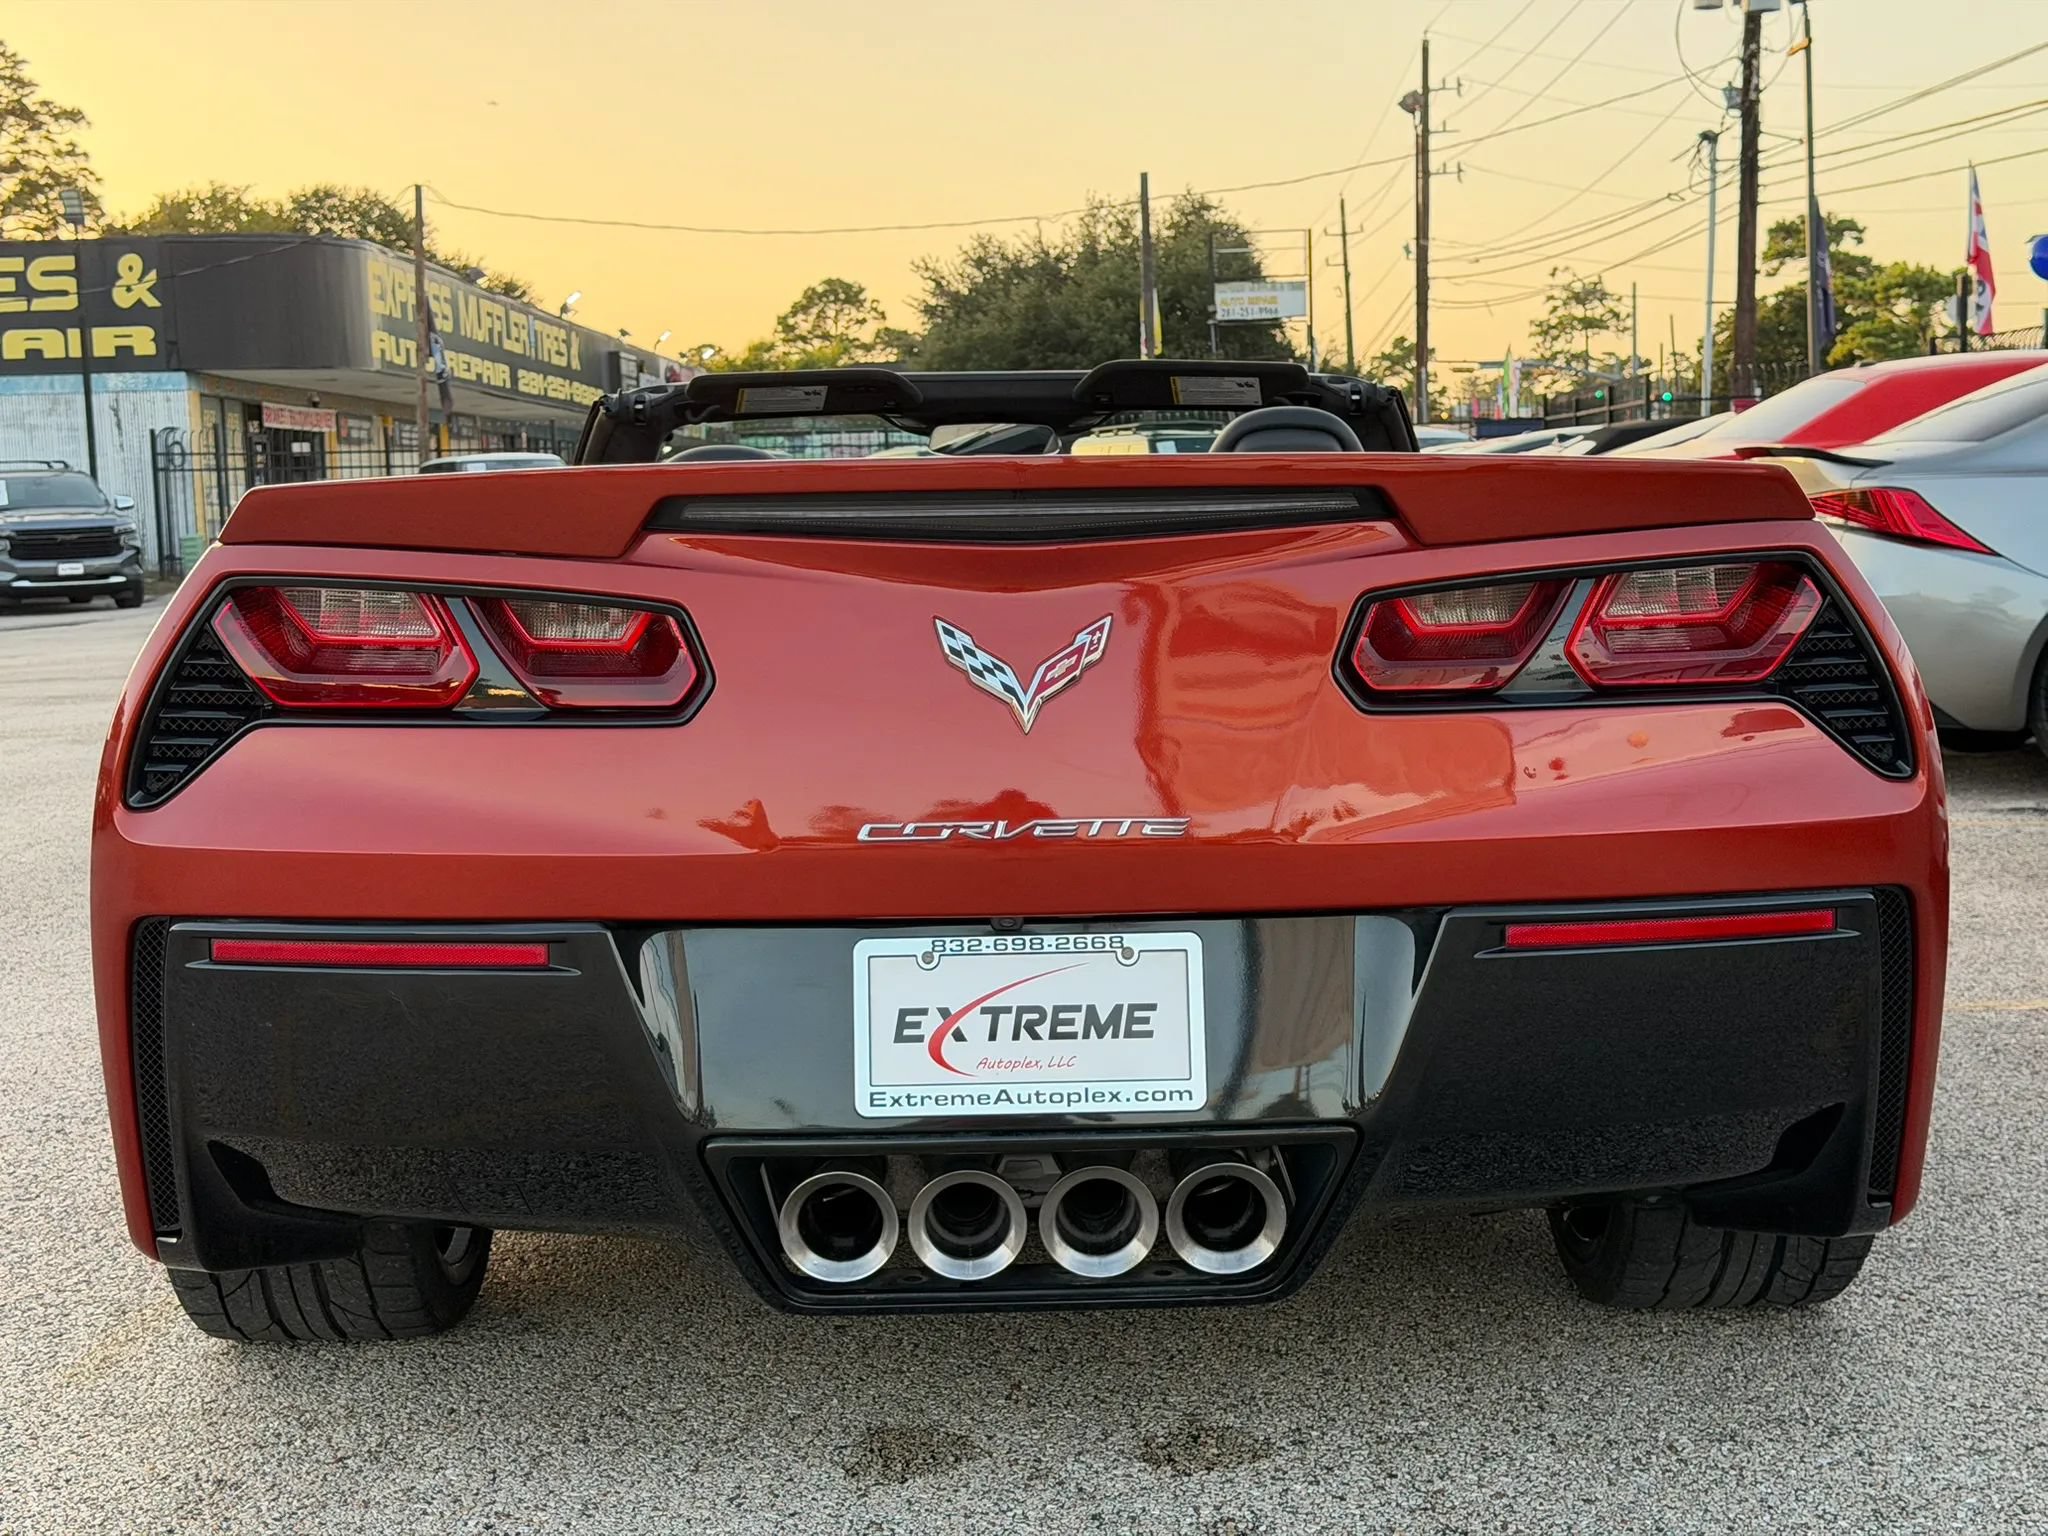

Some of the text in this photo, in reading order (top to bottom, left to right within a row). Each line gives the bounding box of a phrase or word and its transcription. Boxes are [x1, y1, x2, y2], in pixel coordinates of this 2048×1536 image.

[112, 253, 162, 309] &
[457, 289, 530, 357] MUFFLER
[444, 349, 511, 389] REPAIR
[857, 816, 1192, 842] CORVETTE
[931, 935, 1126, 954] 832-698-2668
[893, 1002, 1158, 1044] EXTREME
[976, 1055, 1077, 1072] Autoplex, LLC
[869, 1087, 1194, 1108] ExtremeAutoplex.com
